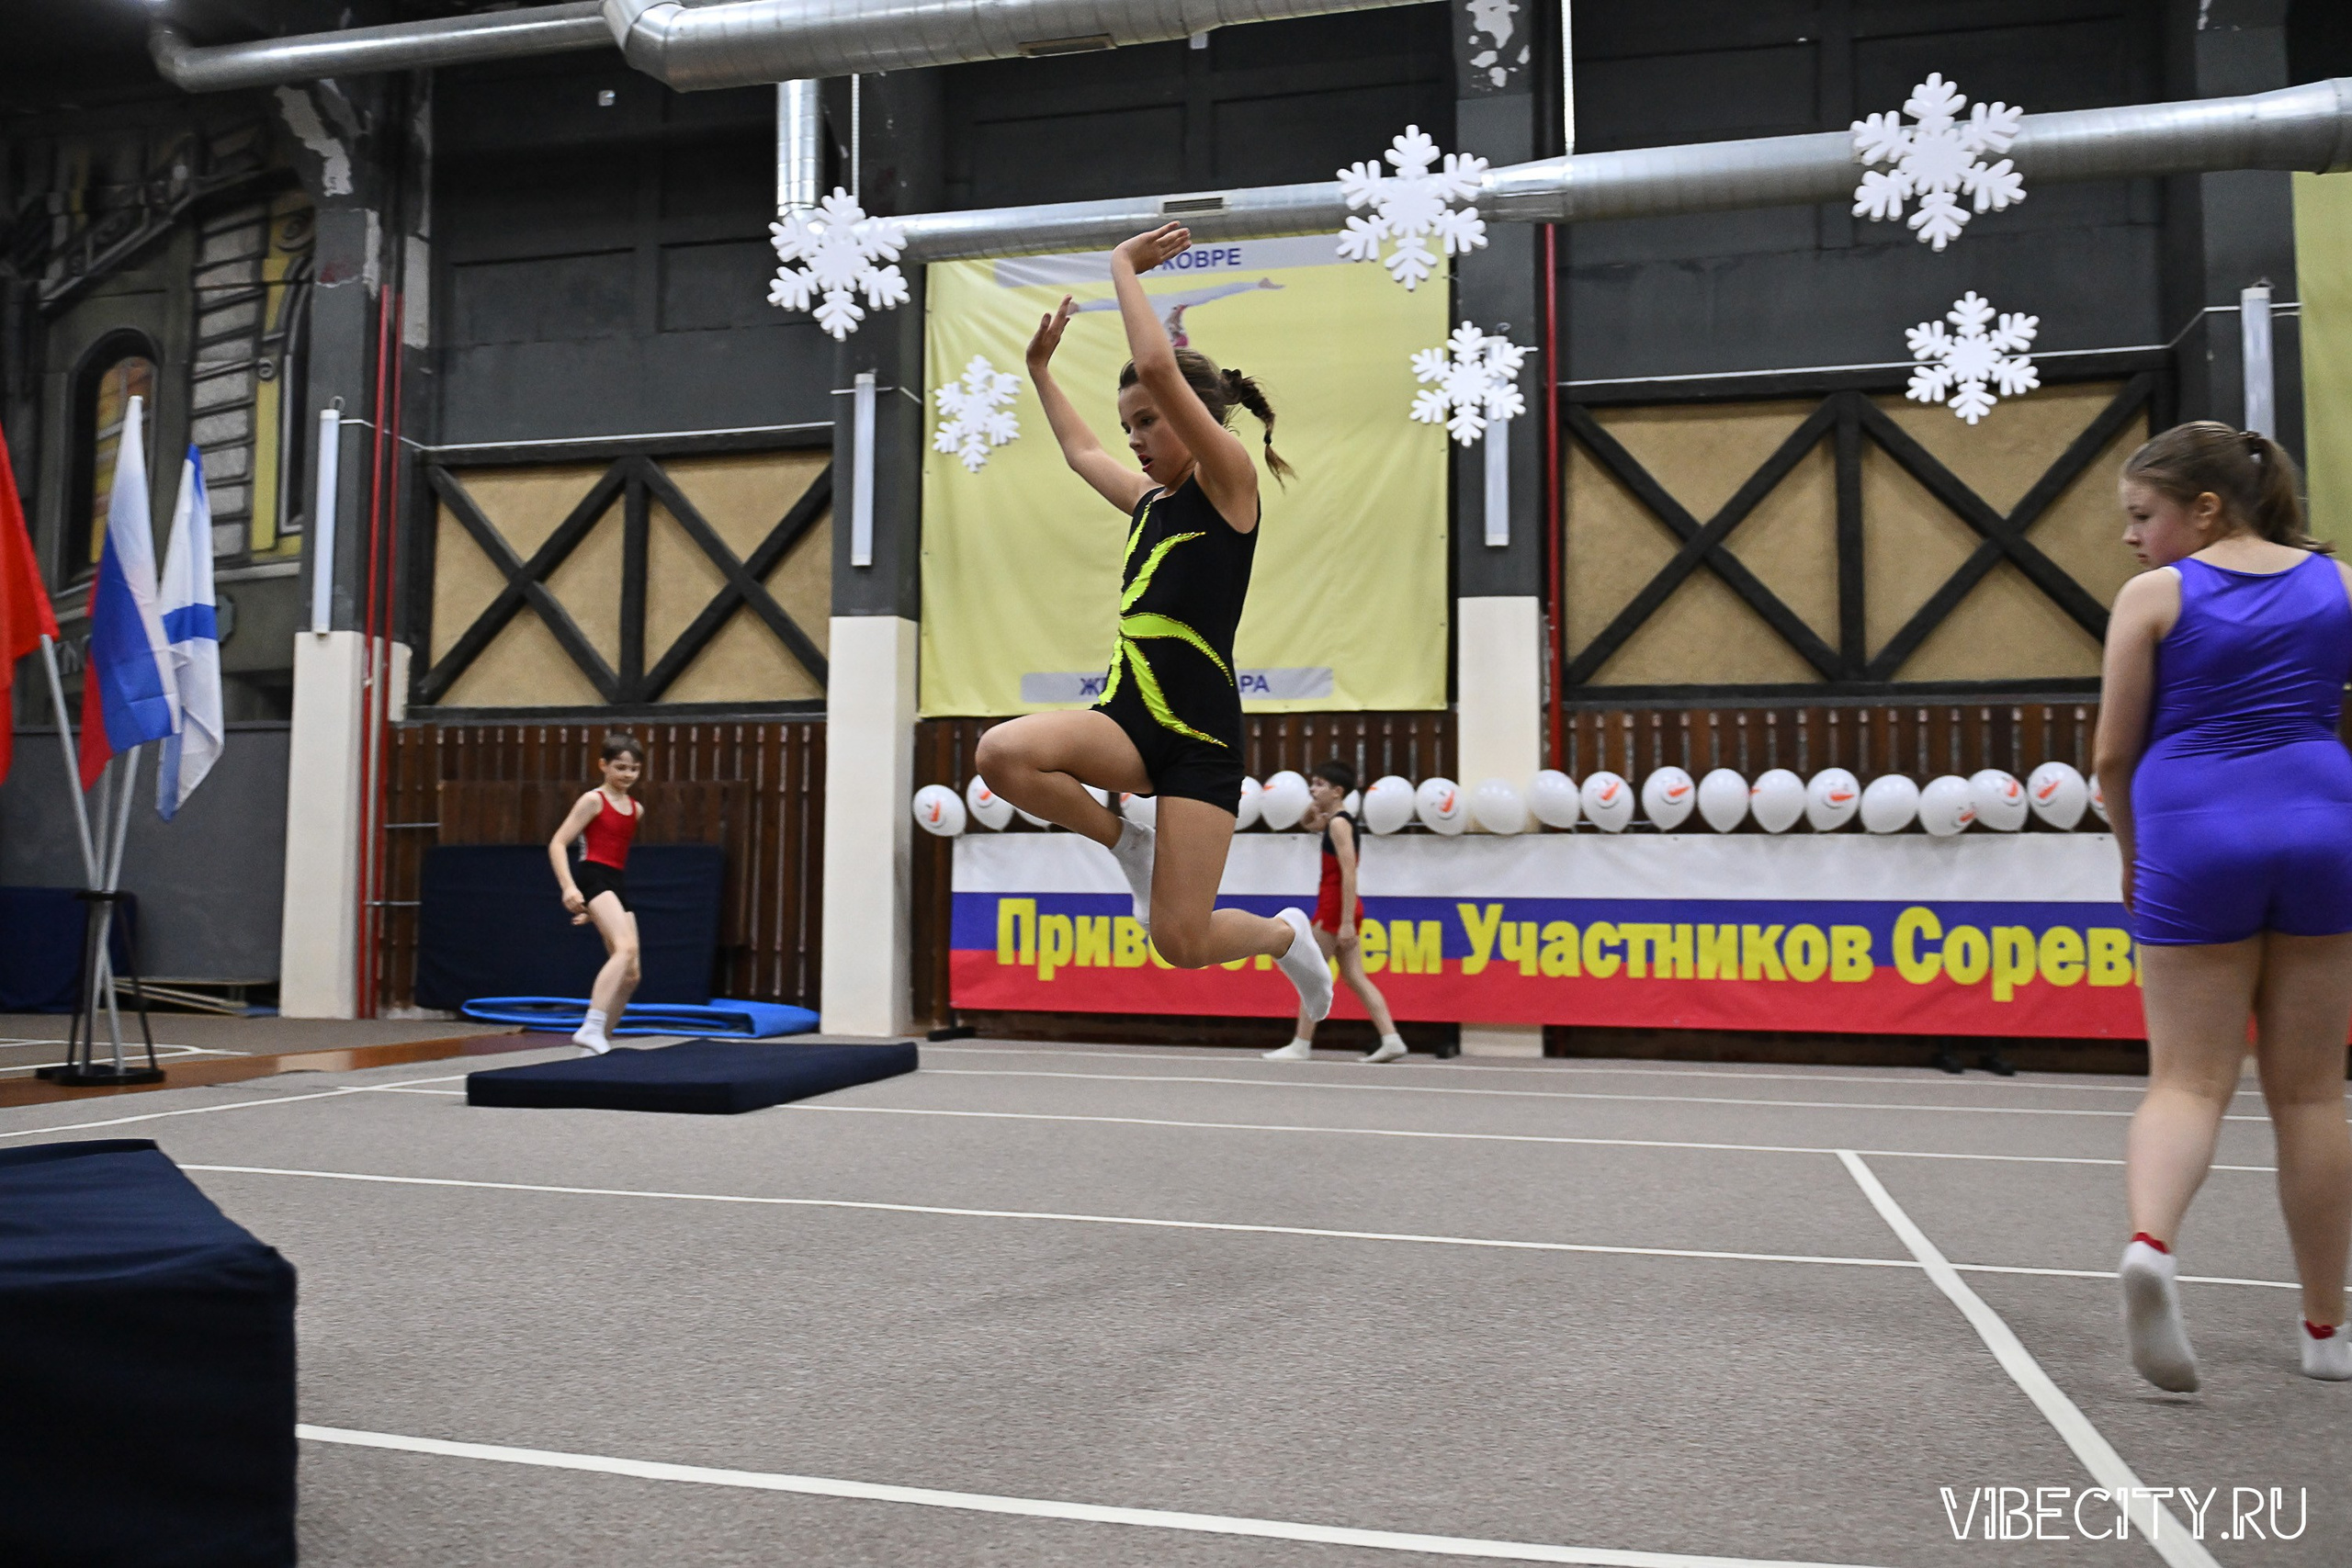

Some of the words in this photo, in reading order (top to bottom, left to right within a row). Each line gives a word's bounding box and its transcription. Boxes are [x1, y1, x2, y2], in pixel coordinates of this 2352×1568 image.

[997, 898, 1442, 981] Привем
[1456, 903, 1875, 982] Участников
[1892, 906, 2143, 1002] Сорев
